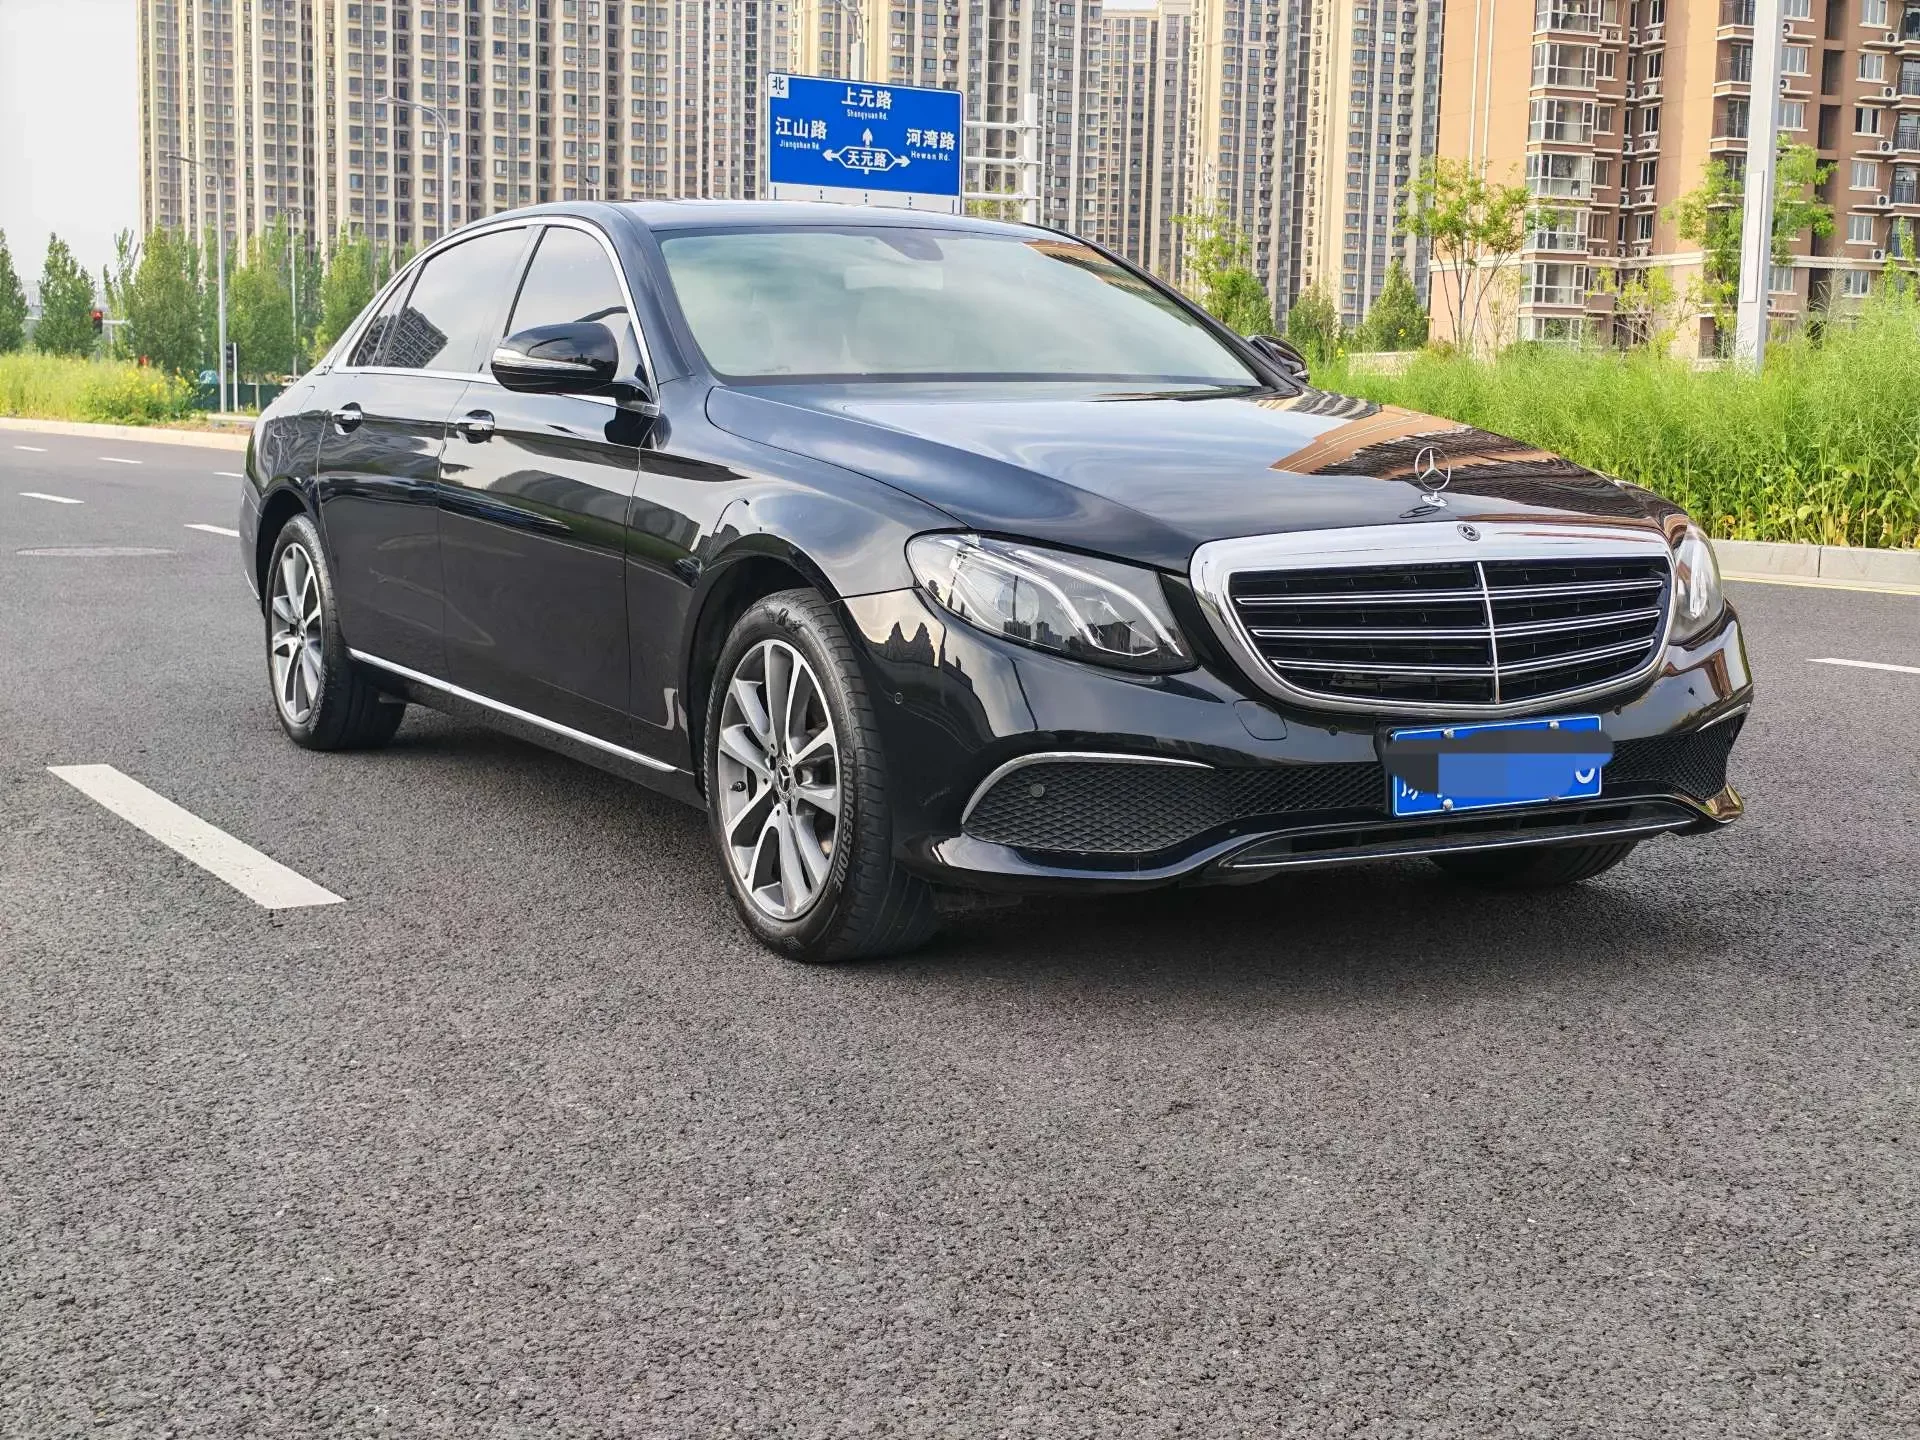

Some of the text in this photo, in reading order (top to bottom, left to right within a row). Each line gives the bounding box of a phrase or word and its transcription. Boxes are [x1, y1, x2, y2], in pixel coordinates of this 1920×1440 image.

[772, 76, 785, 91] 北
[841, 86, 893, 110] 上元路
[847, 108, 878, 120] Shangyuan
[775, 116, 828, 140] 江山路
[780, 139, 811, 151] Jiangshan
[905, 127, 956, 151] 河湾路
[847, 150, 888, 168] 天元路
[910, 150, 936, 161] Hewan
